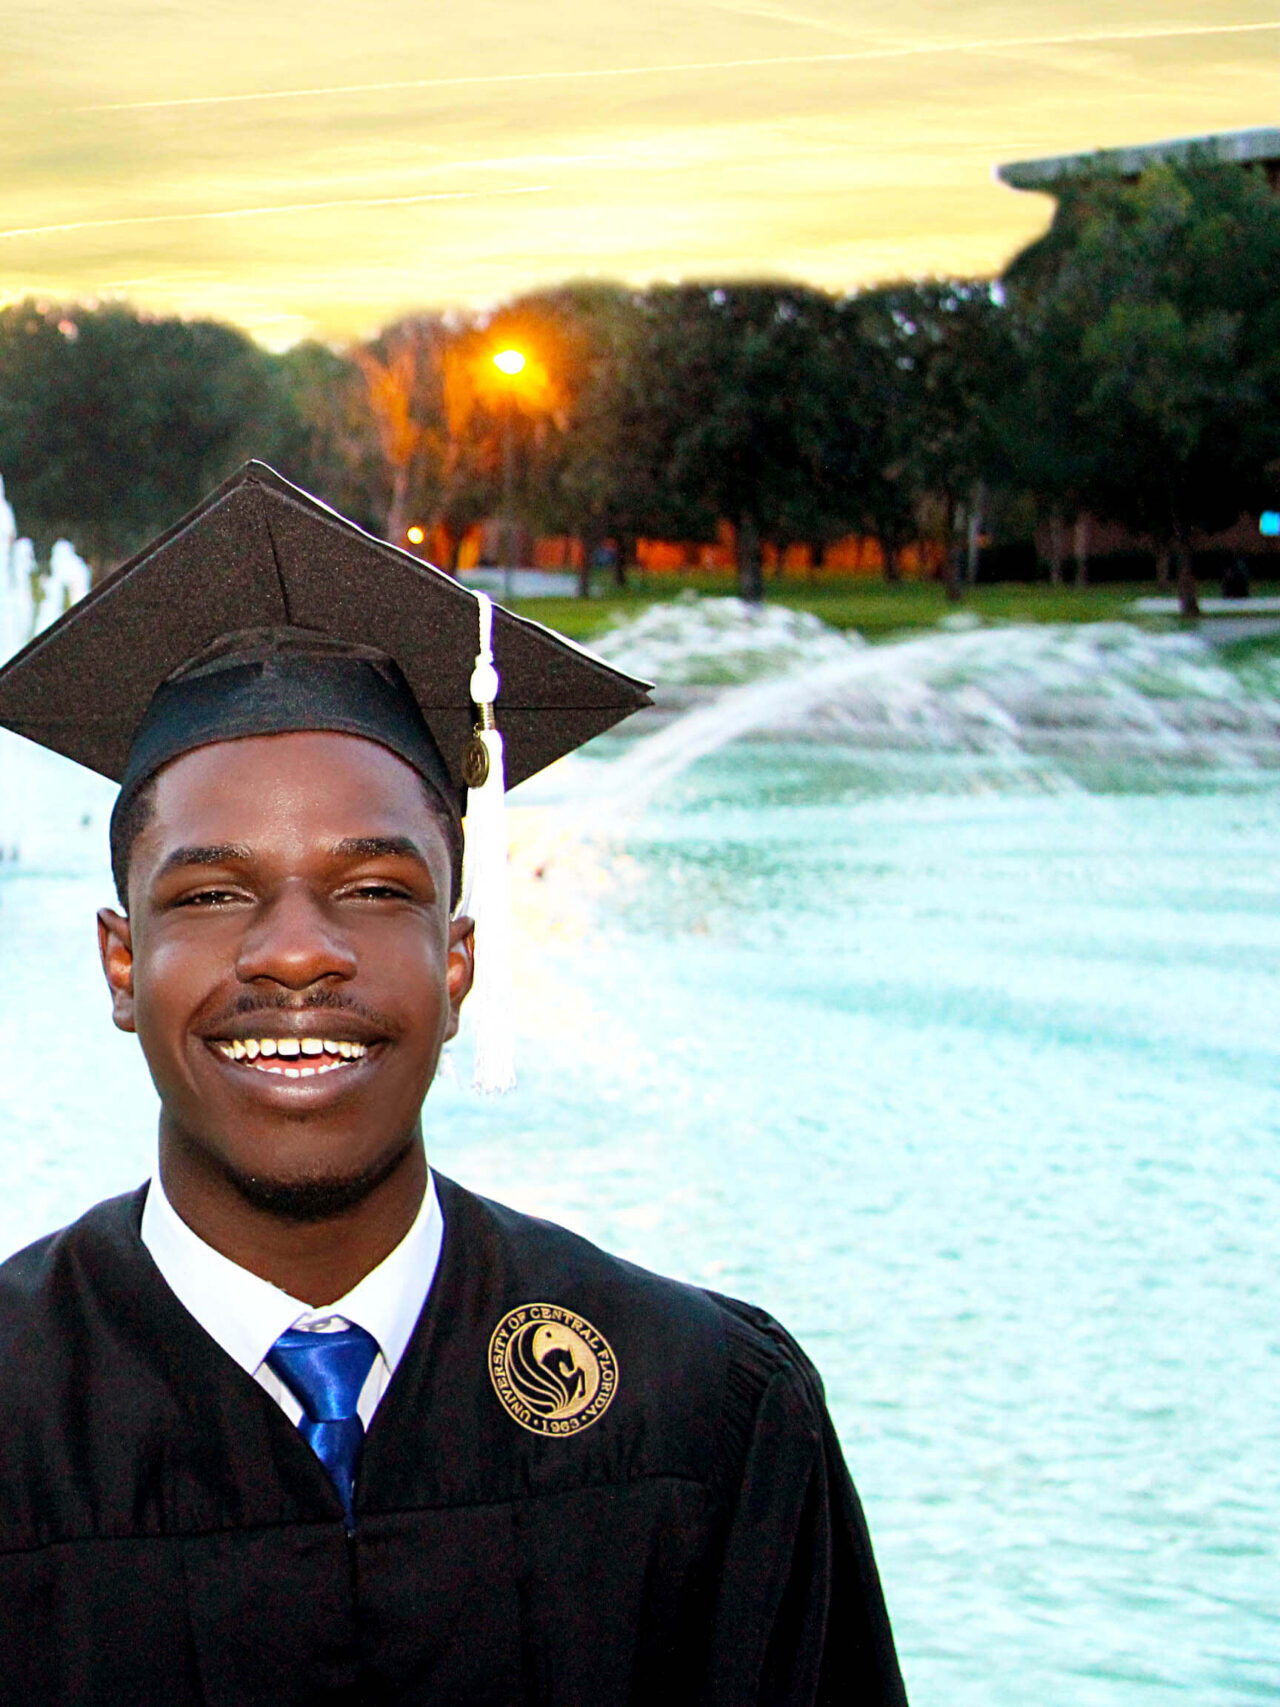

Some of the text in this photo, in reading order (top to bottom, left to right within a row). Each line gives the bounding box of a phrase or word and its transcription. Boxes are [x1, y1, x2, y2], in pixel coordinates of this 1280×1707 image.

[493, 1307, 614, 1422] UNIVERSITY OF CENTRAL FLORIDA
[541, 1419, 580, 1433] 1963
